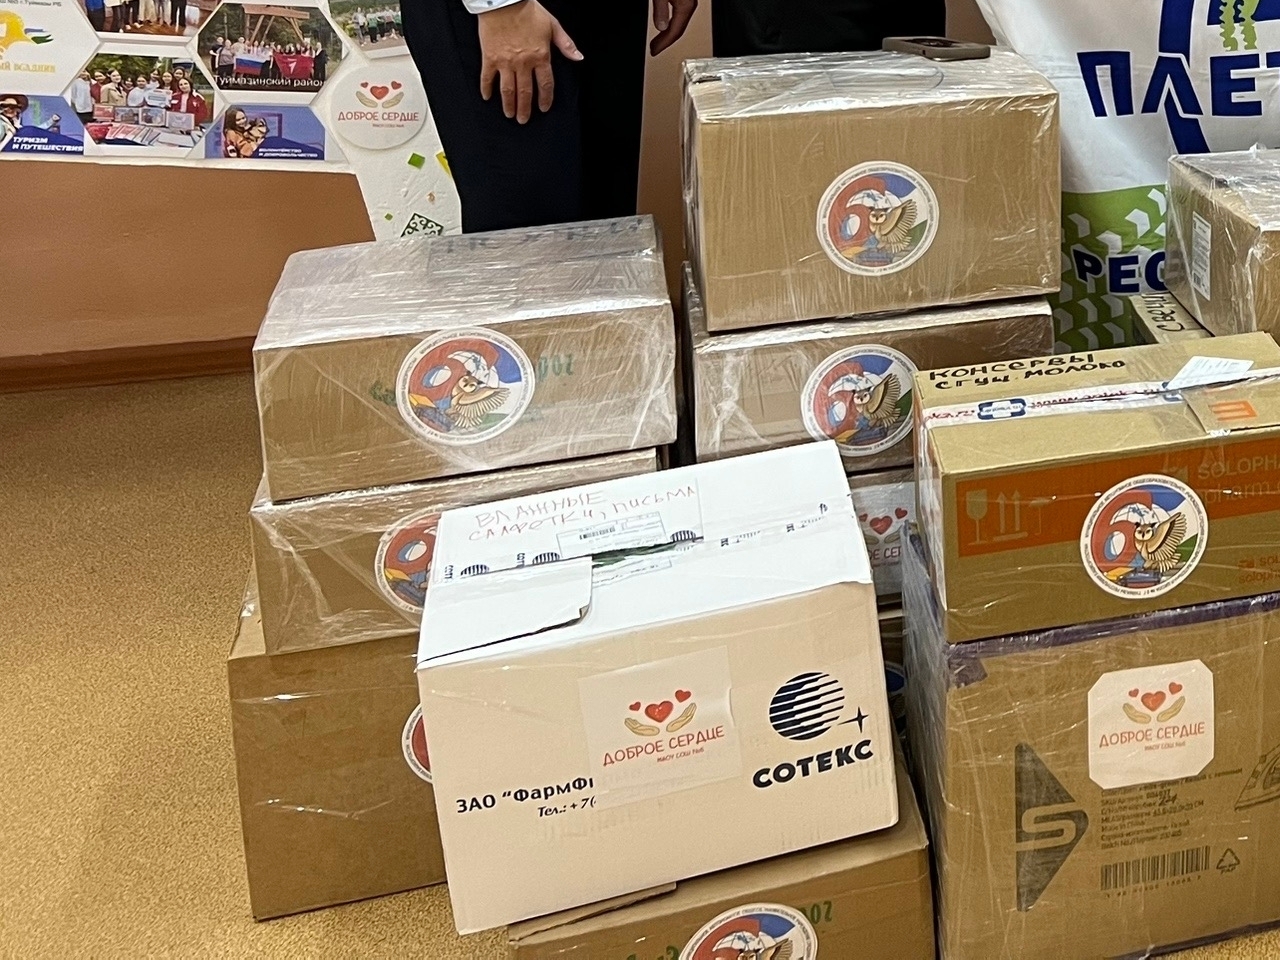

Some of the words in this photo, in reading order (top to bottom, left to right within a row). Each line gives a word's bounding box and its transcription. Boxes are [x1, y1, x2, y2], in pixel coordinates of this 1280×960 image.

[338, 111, 379, 121] ДОБРОЕ
[382, 112, 419, 122] СЕРДЦЕ
[603, 740, 665, 767] ДОБРОЕ
[668, 725, 725, 750] СЕРДЦЕ
[1099, 728, 1153, 748] ДОБРОЕ
[1157, 722, 1205, 739] СЕРДЦЕ
[753, 739, 873, 788] СОТЕКС
[456, 793, 496, 813] ЗАО
